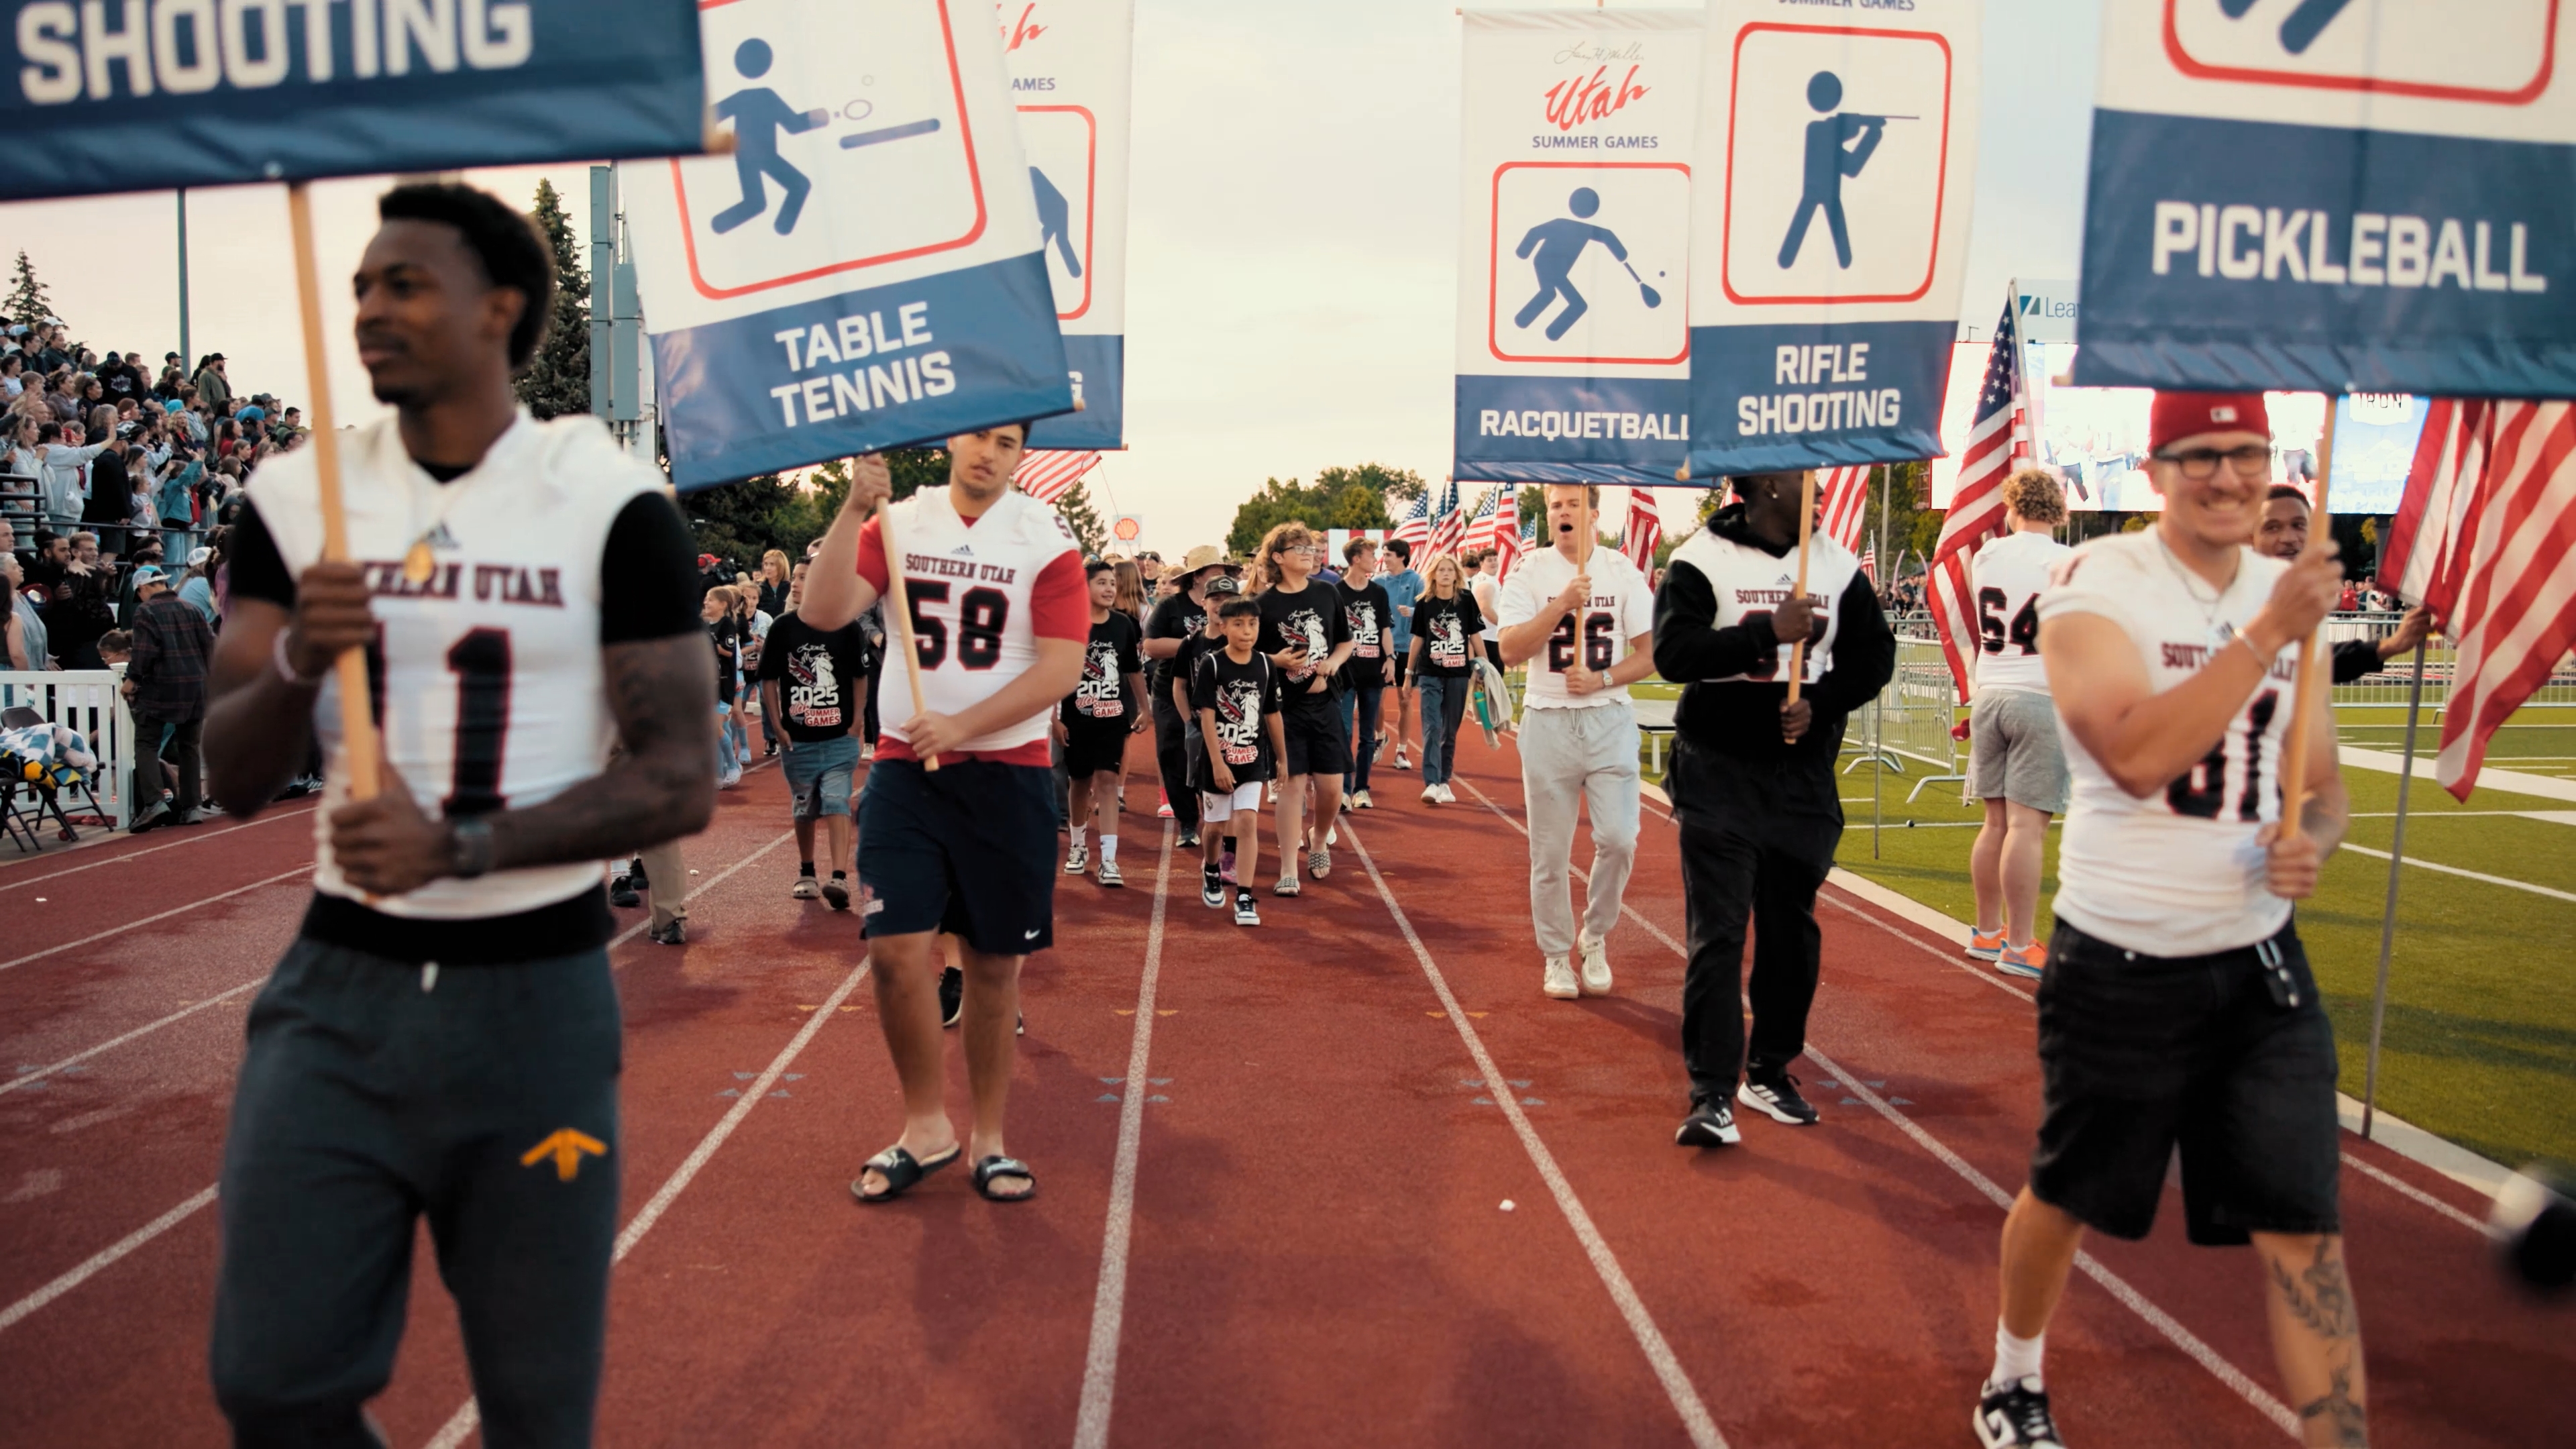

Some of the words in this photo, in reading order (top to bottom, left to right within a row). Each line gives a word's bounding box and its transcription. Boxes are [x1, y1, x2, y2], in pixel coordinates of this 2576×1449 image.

[1860, 0, 1915, 11] GAMES
[16, 0, 534, 106] SHOOTING
[1011, 78, 1056, 91] AMES
[1544, 64, 1651, 131] Utah
[1532, 136, 1599, 148] SUMMER
[1604, 136, 1659, 148] GAMES
[2151, 201, 2548, 293] PICKLEBALL
[2046, 297, 2079, 318] Lea
[774, 301, 933, 372] TABLE
[1775, 343, 1870, 385] RIFLE
[770, 351, 957, 428] TENNIS
[1737, 388, 1901, 436] SHOOTING
[906, 553, 975, 581] SOUTHERN
[981, 564, 1016, 584] UTAH
[473, 564, 565, 609] UTAH
[1735, 589, 1792, 605] SOUTHE
[1595, 595, 1615, 608] UTAH
[904, 576, 1010, 672] 58
[1978, 586, 2041, 656] 64
[1353, 630, 1379, 644] 025
[1430, 639, 1465, 655] 2025
[1549, 611, 1615, 674] 26
[2161, 641, 2222, 669] SOUT
[790, 686, 840, 707] 2025
[1077, 680, 1120, 700] 2025
[805, 708, 840, 717] SUMMER
[1093, 700, 1123, 709] SUMMER
[1093, 707, 1124, 717] GAMES
[806, 716, 841, 726] GAMES
